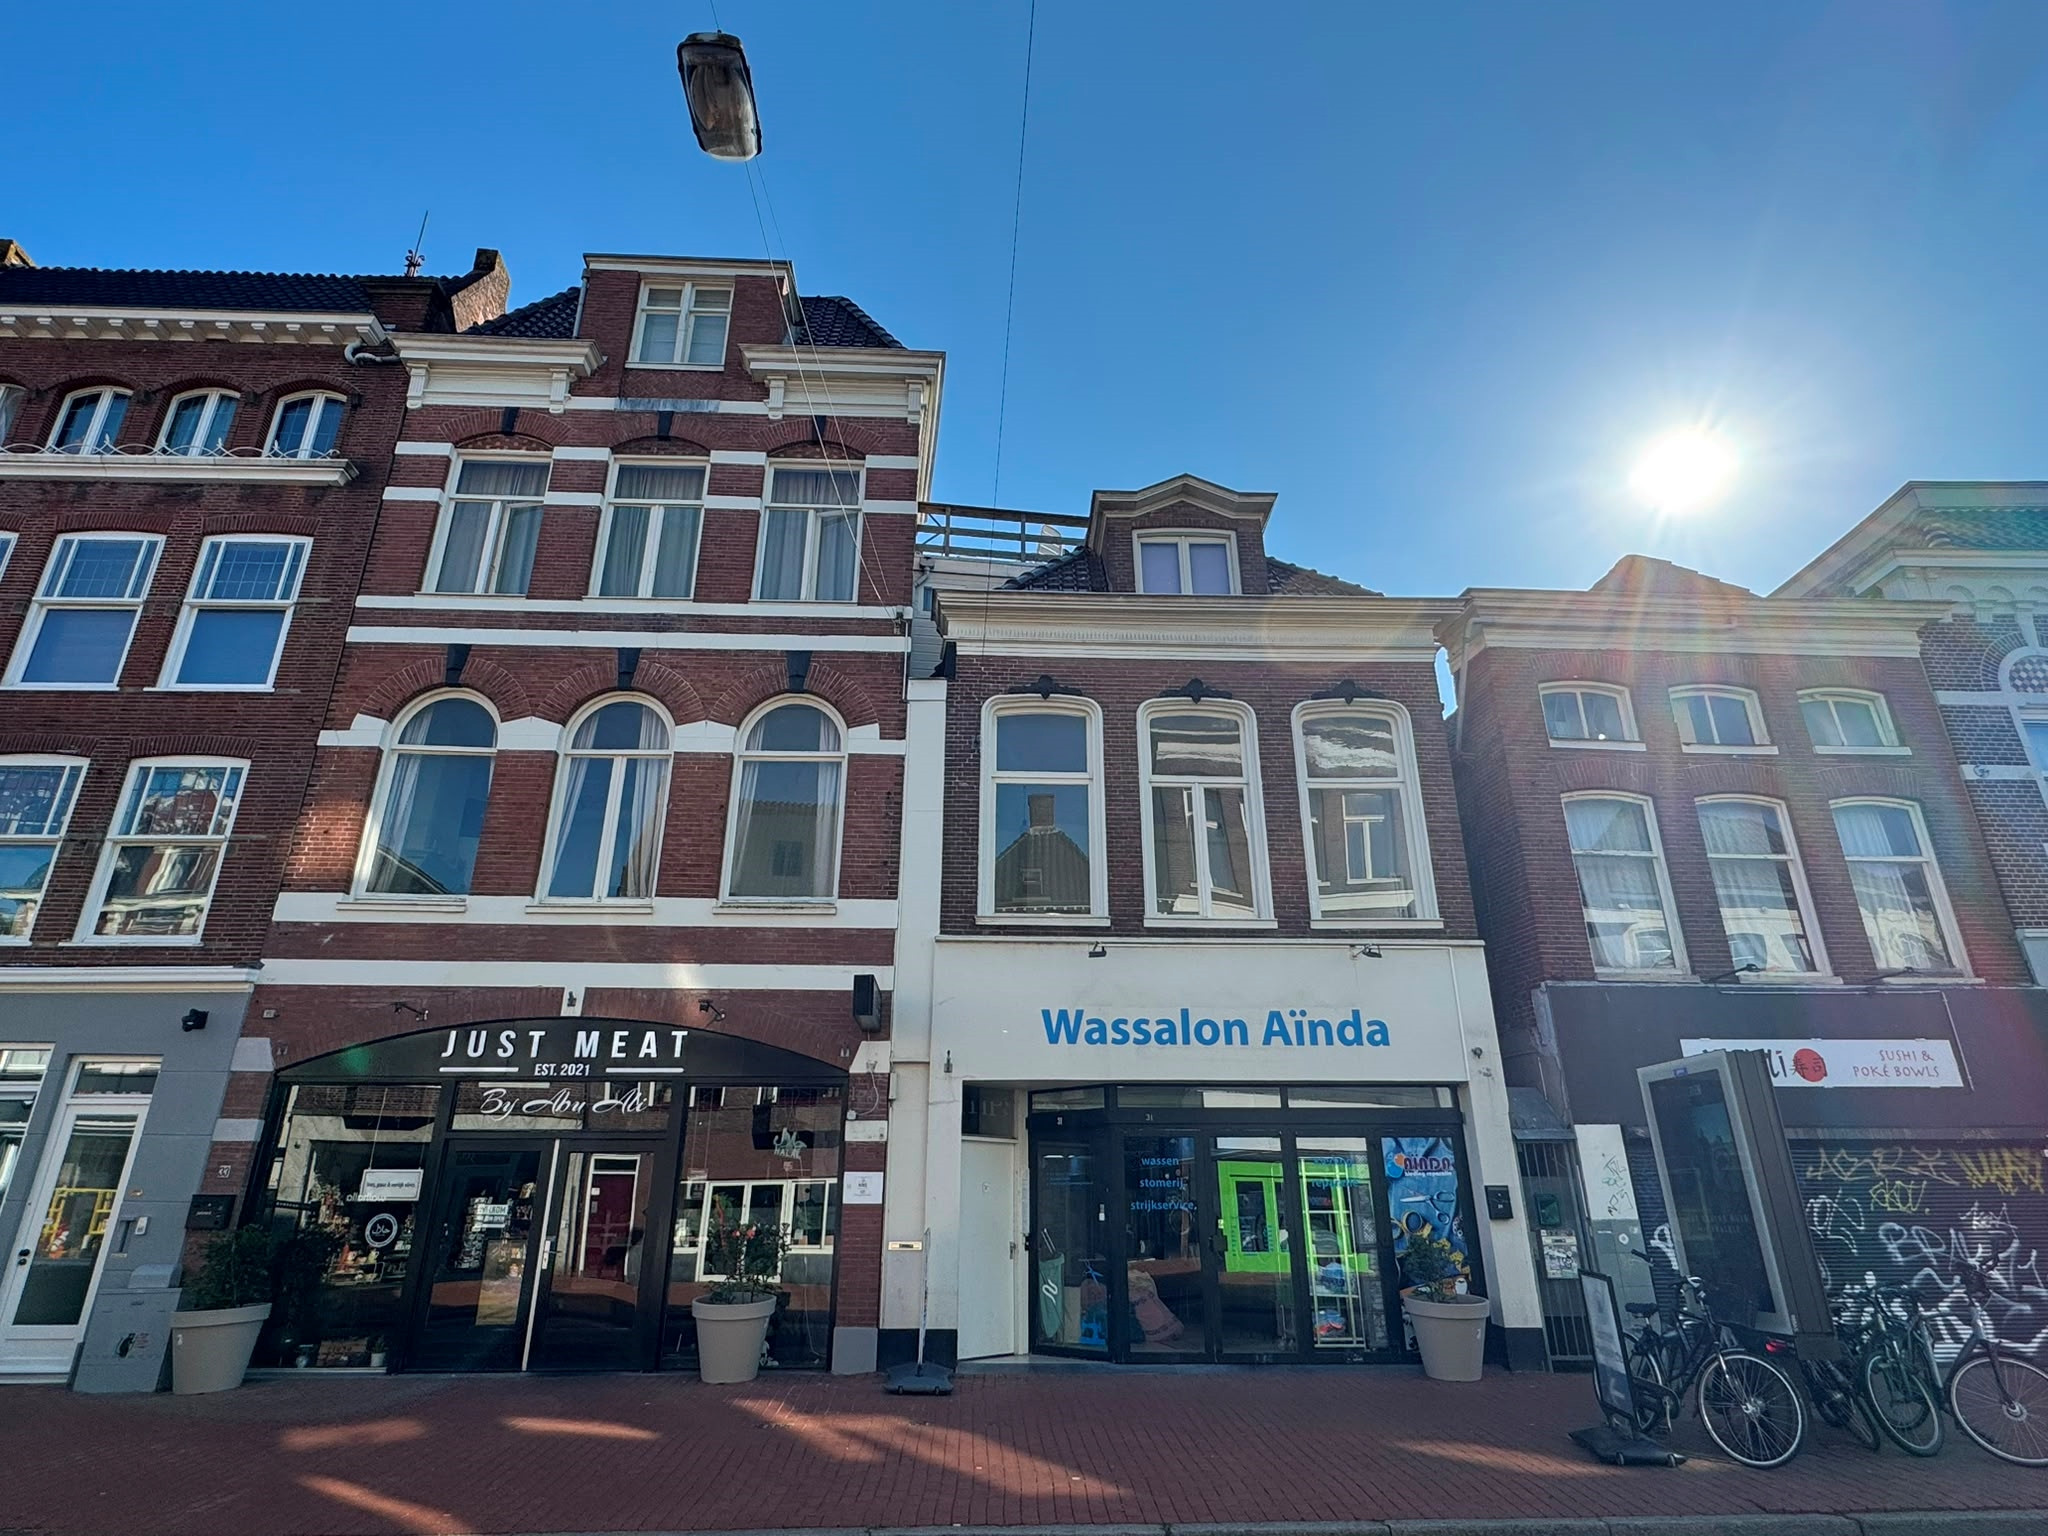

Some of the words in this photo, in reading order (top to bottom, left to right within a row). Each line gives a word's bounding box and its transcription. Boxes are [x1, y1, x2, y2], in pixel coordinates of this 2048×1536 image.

[1041, 1008, 1249, 1046] Wassalon
[1262, 1009, 1391, 1047] Aïnda
[441, 1030, 546, 1058] JUST
[574, 1030, 689, 1059] MEAT
[1879, 1050, 1917, 1062] SUSHI
[1921, 1050, 1935, 1062] &
[534, 1064, 558, 1076] EST.
[560, 1064, 591, 1077] 2021
[1852, 1064, 1890, 1078] POKÉ
[1895, 1065, 1939, 1078] BOWLS
[480, 1088, 520, 1121] By
[522, 1088, 587, 1115] Abu
[592, 1087, 650, 1114] Ali
[1141, 1157, 1179, 1166] wassen
[1139, 1178, 1184, 1189] stomerij
